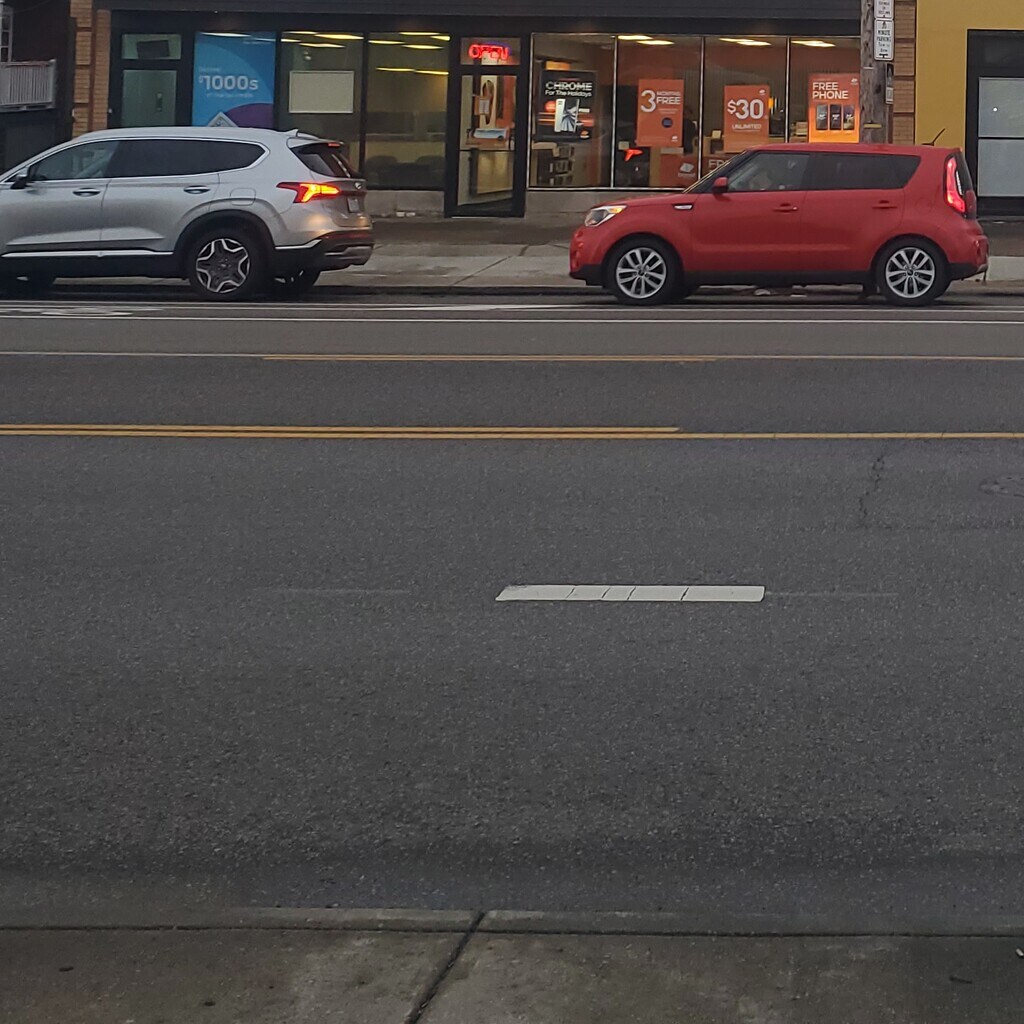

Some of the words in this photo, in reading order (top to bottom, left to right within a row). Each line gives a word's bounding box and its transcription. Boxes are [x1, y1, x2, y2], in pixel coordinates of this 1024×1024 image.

[468, 44, 510, 60] OPEN
[545, 81, 593, 91] CHROME
[812, 81, 839, 91] FREE
[812, 90, 849, 100] PHONE
[640, 89, 657, 113] 3
[656, 97, 681, 105] FREE
[727, 99, 764, 119] $30
